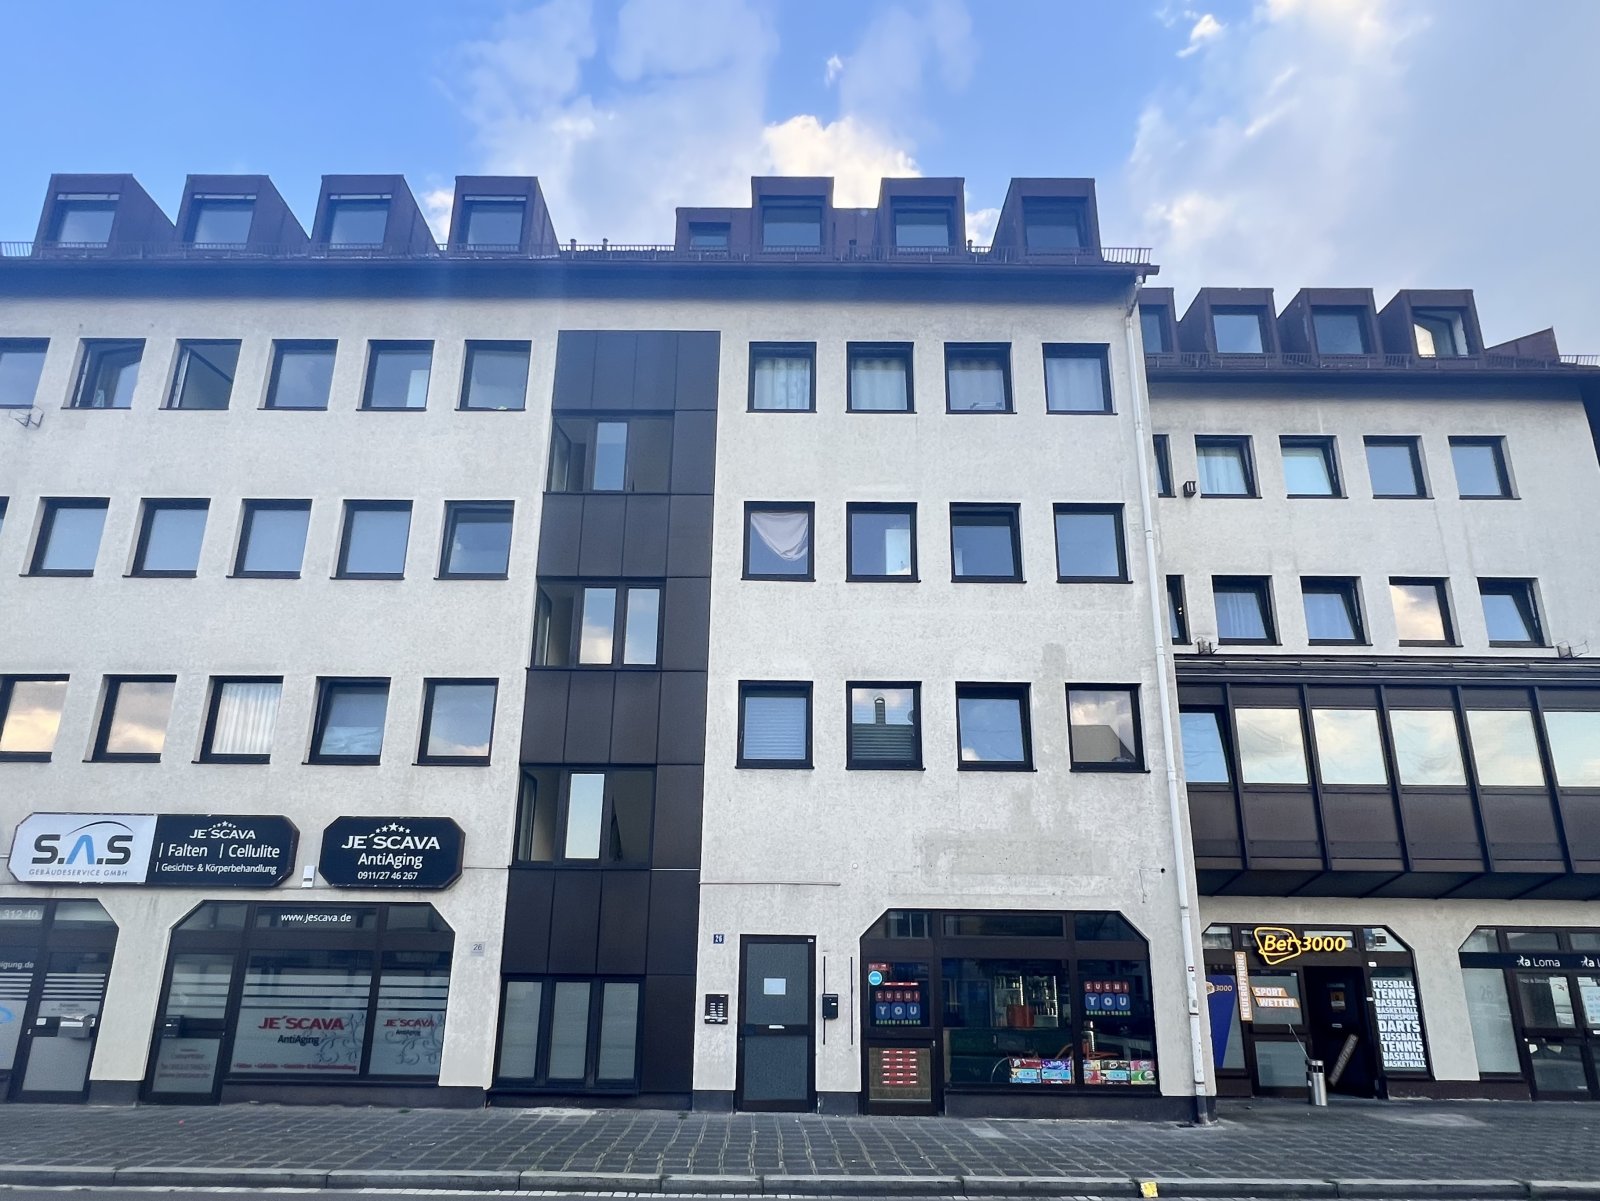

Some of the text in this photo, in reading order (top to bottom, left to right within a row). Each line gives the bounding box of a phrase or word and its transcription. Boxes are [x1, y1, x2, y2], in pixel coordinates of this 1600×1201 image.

[168, 844, 280, 858] Falten Cellulite
[357, 853, 423, 869] AntiAging
[28, 868, 101, 877] GEBÄUDESERVICE
[161, 863, 278, 875] Gesichts- & Körperbehandlung
[357, 871, 418, 880] 0911/27 46 267
[281, 913, 352, 923] www.jescava.de
[714, 934, 723, 943] 26
[472, 943, 483, 951] 26
[1532, 957, 1561, 967] Loma
[1372, 980, 1414, 989] FUSSBALL
[1255, 987, 1282, 997] SPORT
[1373, 988, 1416, 999] TENNIS
[1259, 998, 1295, 1008] WETTEN
[1375, 999, 1417, 1008] BASEBALL
[1378, 1021, 1421, 1032] DARTS
[277, 1035, 320, 1046] AntiAging
[1380, 1032, 1422, 1040] FUSSBALL
[1381, 1041, 1424, 1052] TENNIS
[1382, 1052, 1425, 1060] BASEBALL
[1383, 1060, 1427, 1068] BASKETBALL
